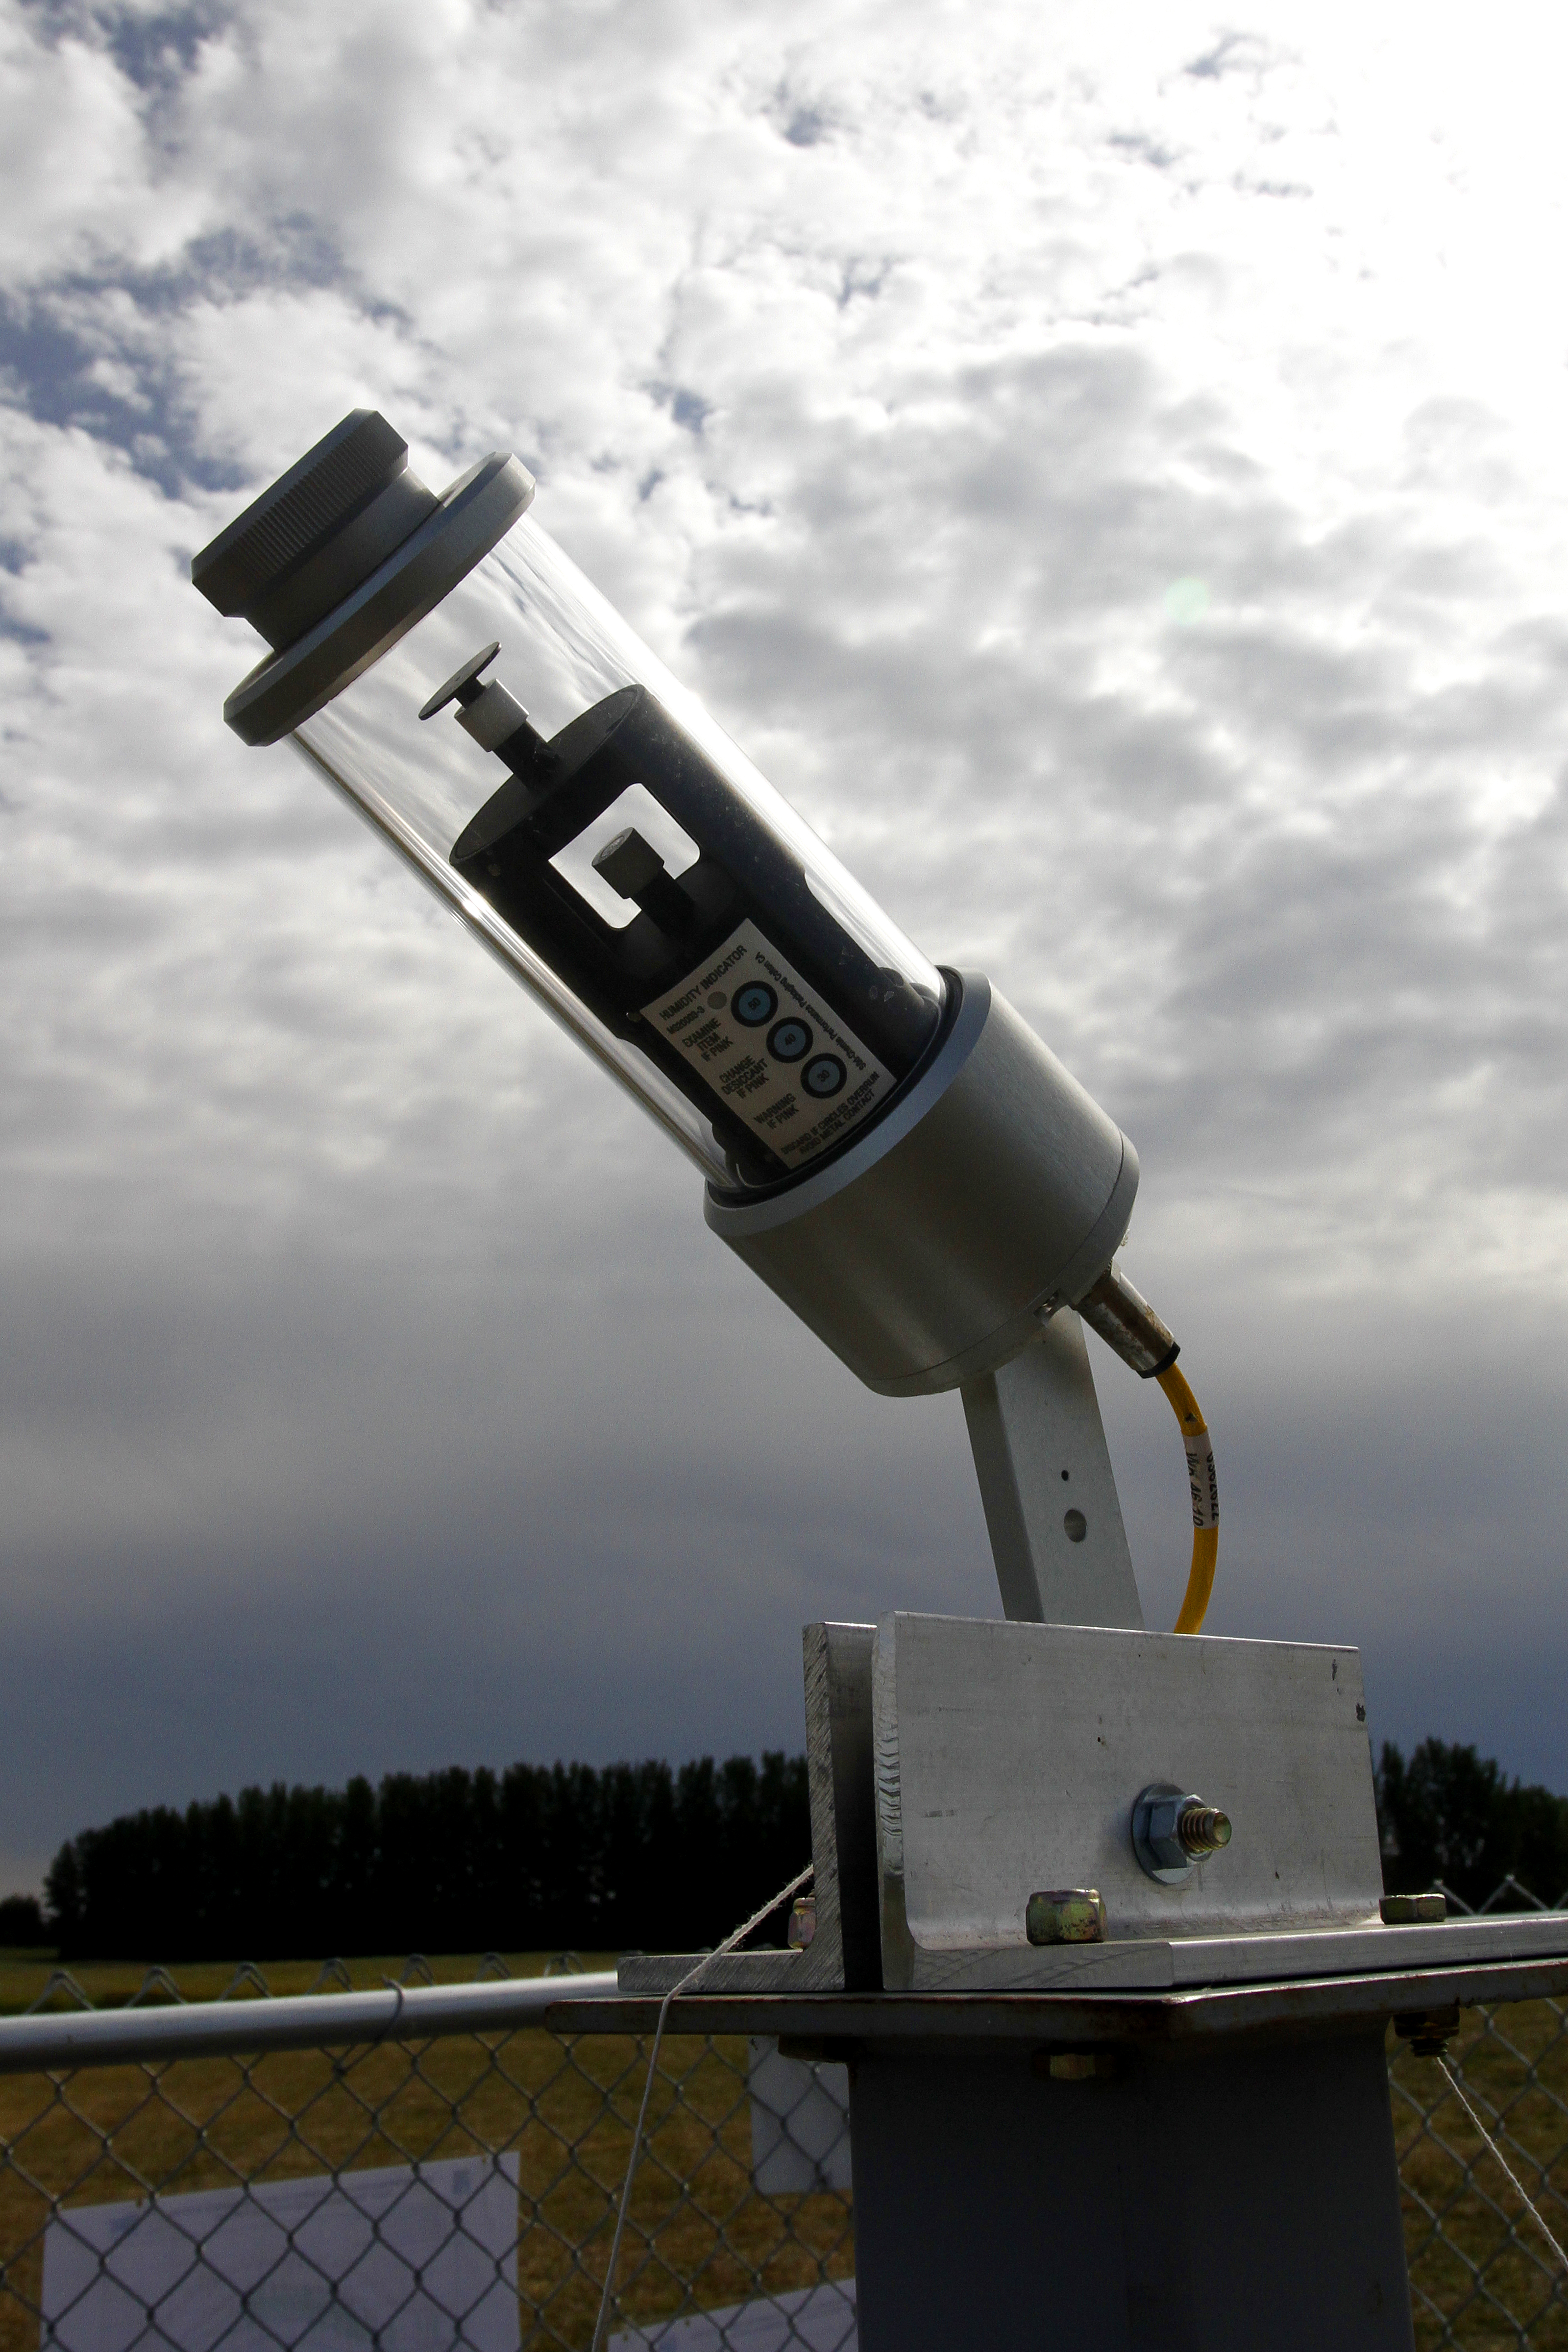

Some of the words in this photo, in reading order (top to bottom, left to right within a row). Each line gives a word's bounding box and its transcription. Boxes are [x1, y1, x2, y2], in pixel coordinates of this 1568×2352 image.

[755, 952, 765, 964] CA
[659, 985, 701, 1021] HUMIDITY
[700, 945, 747, 990] INDICATOR
[780, 977, 807, 1008] Packaging
[748, 997, 761, 1010] 50
[682, 1018, 721, 1048] EXAMINE
[697, 1032, 720, 1051] ITEM
[784, 1033, 796, 1046] 40
[701, 1051, 710, 1062] IF
[709, 1036, 734, 1056] PINK
[719, 1055, 756, 1083] CHANGE
[721, 1058, 767, 1095] DESICCANT
[817, 1069, 830, 1082] 30
[736, 1087, 746, 1099] IF
[744, 1073, 769, 1093] PINK
[753, 1093, 796, 1124] WARNING
[766, 1119, 777, 1129] IF
[775, 1104, 799, 1124] PINK
[781, 1132, 812, 1155] DISCARD
[810, 1126, 819, 1136] IF
[818, 1103, 849, 1130] CIRCLES
[847, 1072, 880, 1106] OVERRUN
[799, 1137, 821, 1154] AVOID
[819, 1120, 846, 1140] METAL
[843, 1089, 875, 1121] CONTACT
